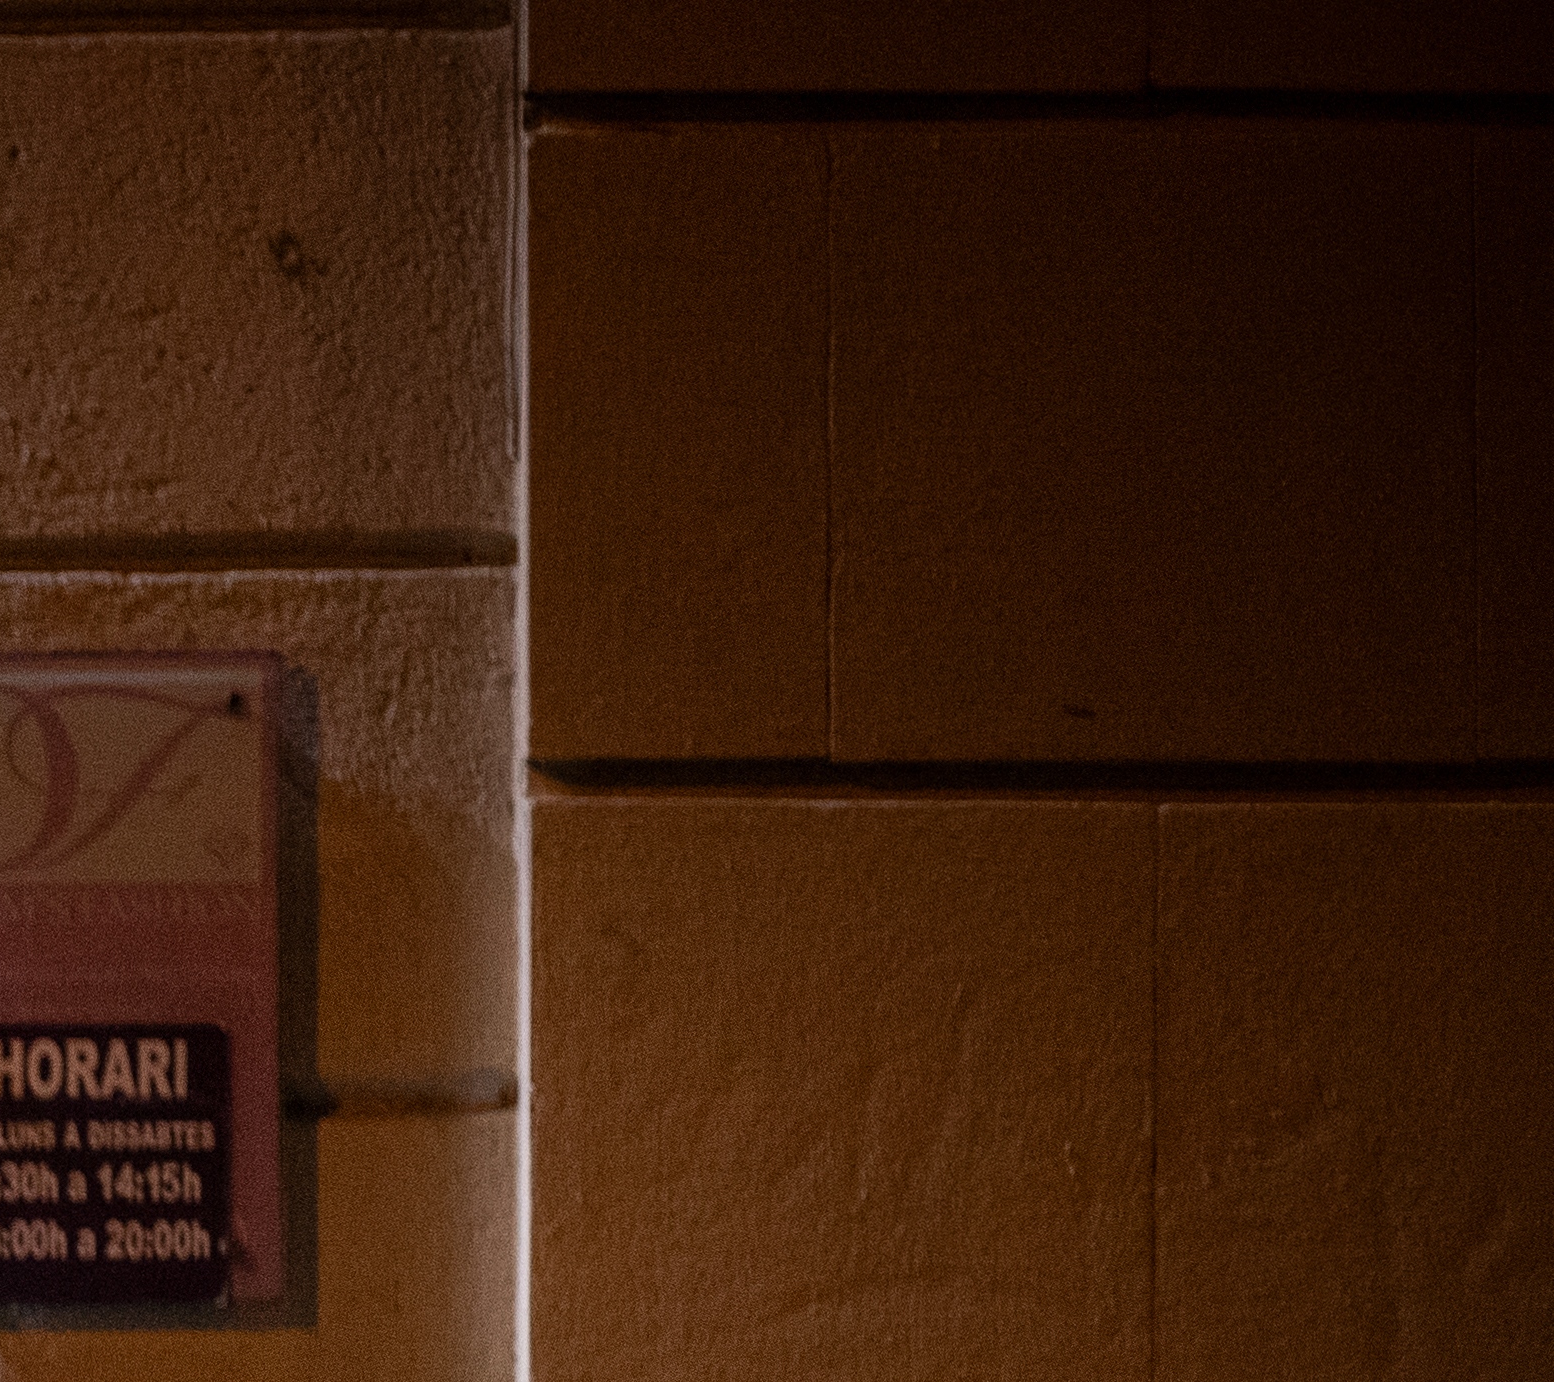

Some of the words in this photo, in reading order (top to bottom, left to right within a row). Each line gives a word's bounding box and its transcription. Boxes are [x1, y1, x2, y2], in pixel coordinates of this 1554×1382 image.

[63, 1121, 81, 1149] A
[67, 1170, 88, 1202] a
[97, 1161, 203, 1202] 14:15h
[76, 1227, 97, 1260] a
[104, 1218, 211, 1260] 20:00h
